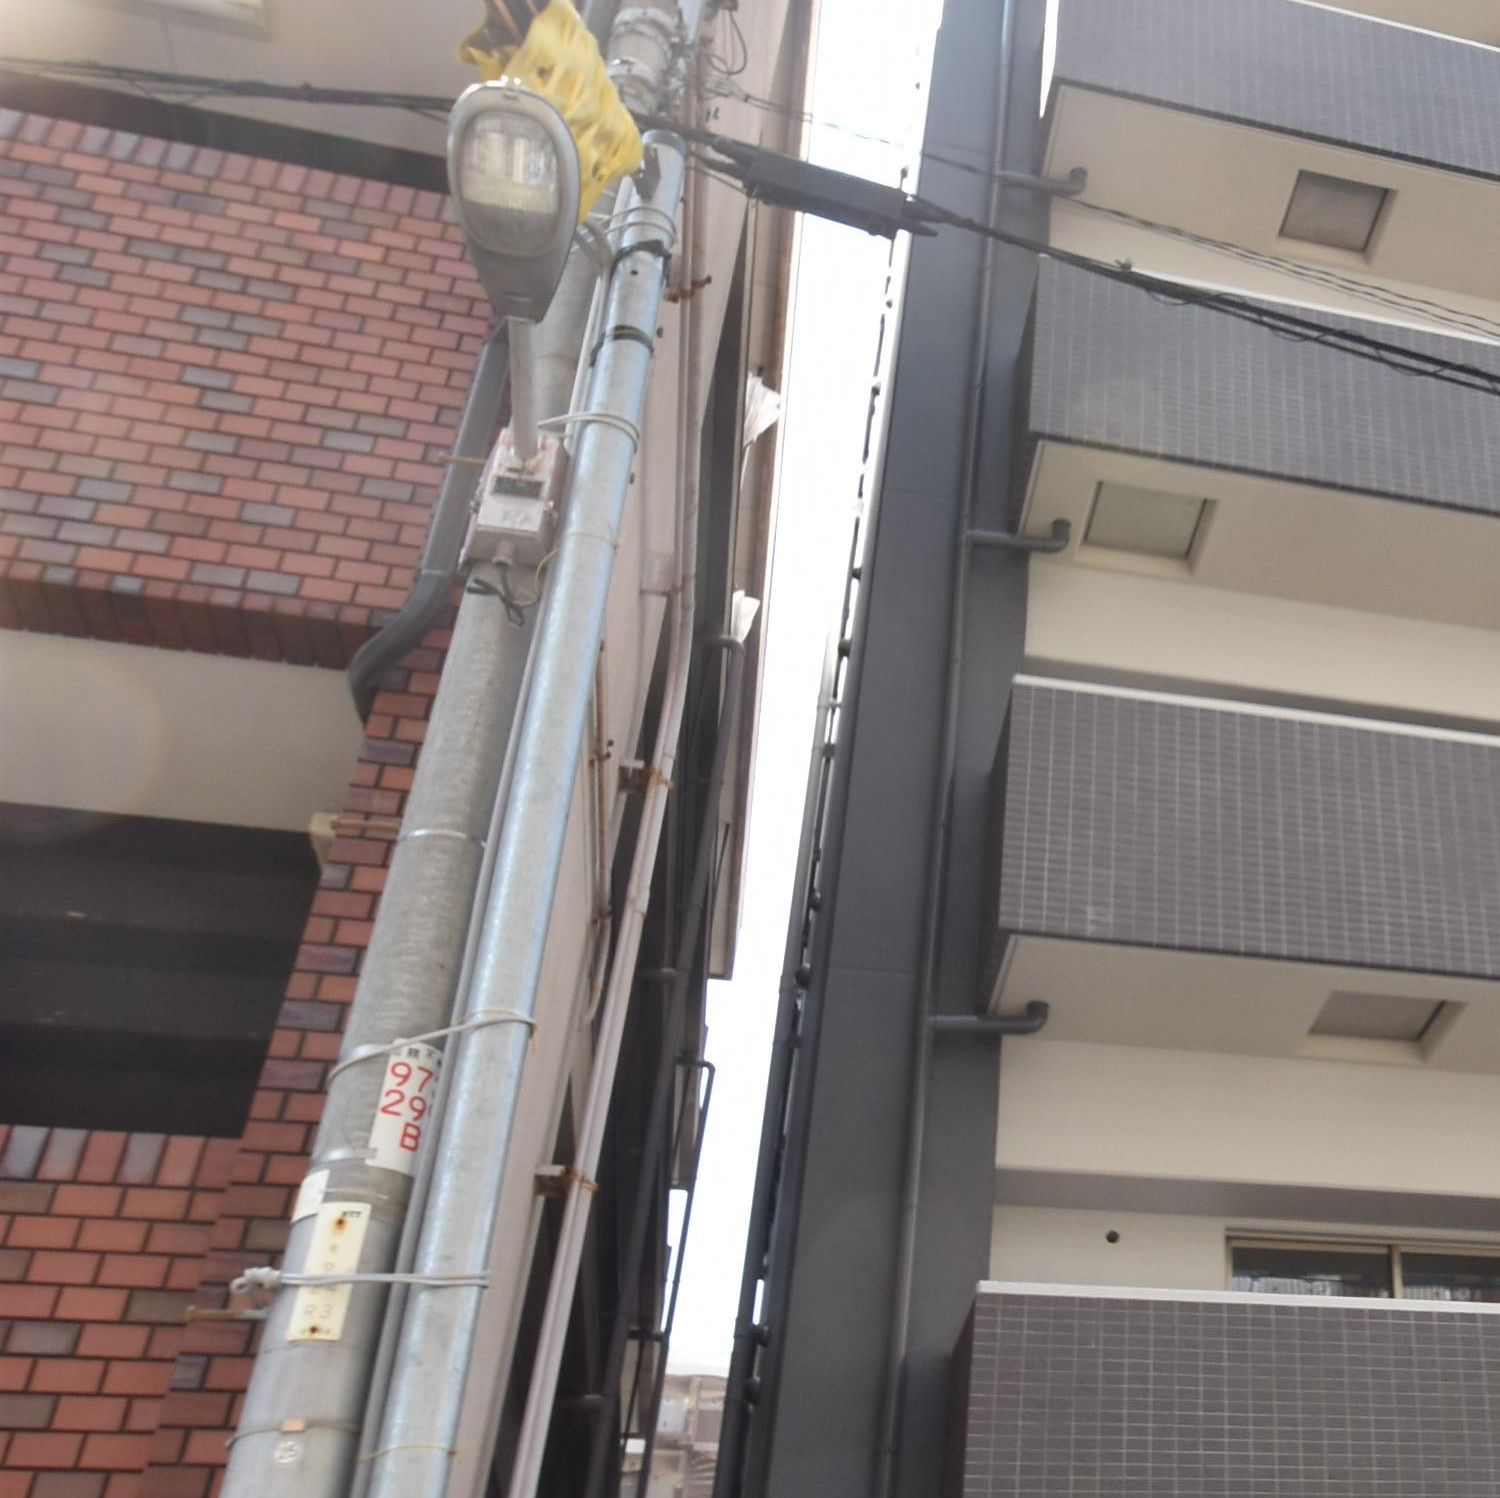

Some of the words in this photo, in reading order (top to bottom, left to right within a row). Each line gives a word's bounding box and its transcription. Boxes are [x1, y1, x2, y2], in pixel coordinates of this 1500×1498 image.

[391, 1061, 433, 1092] 97
[381, 1089, 427, 1122] 29
[399, 1122, 422, 1152] B
